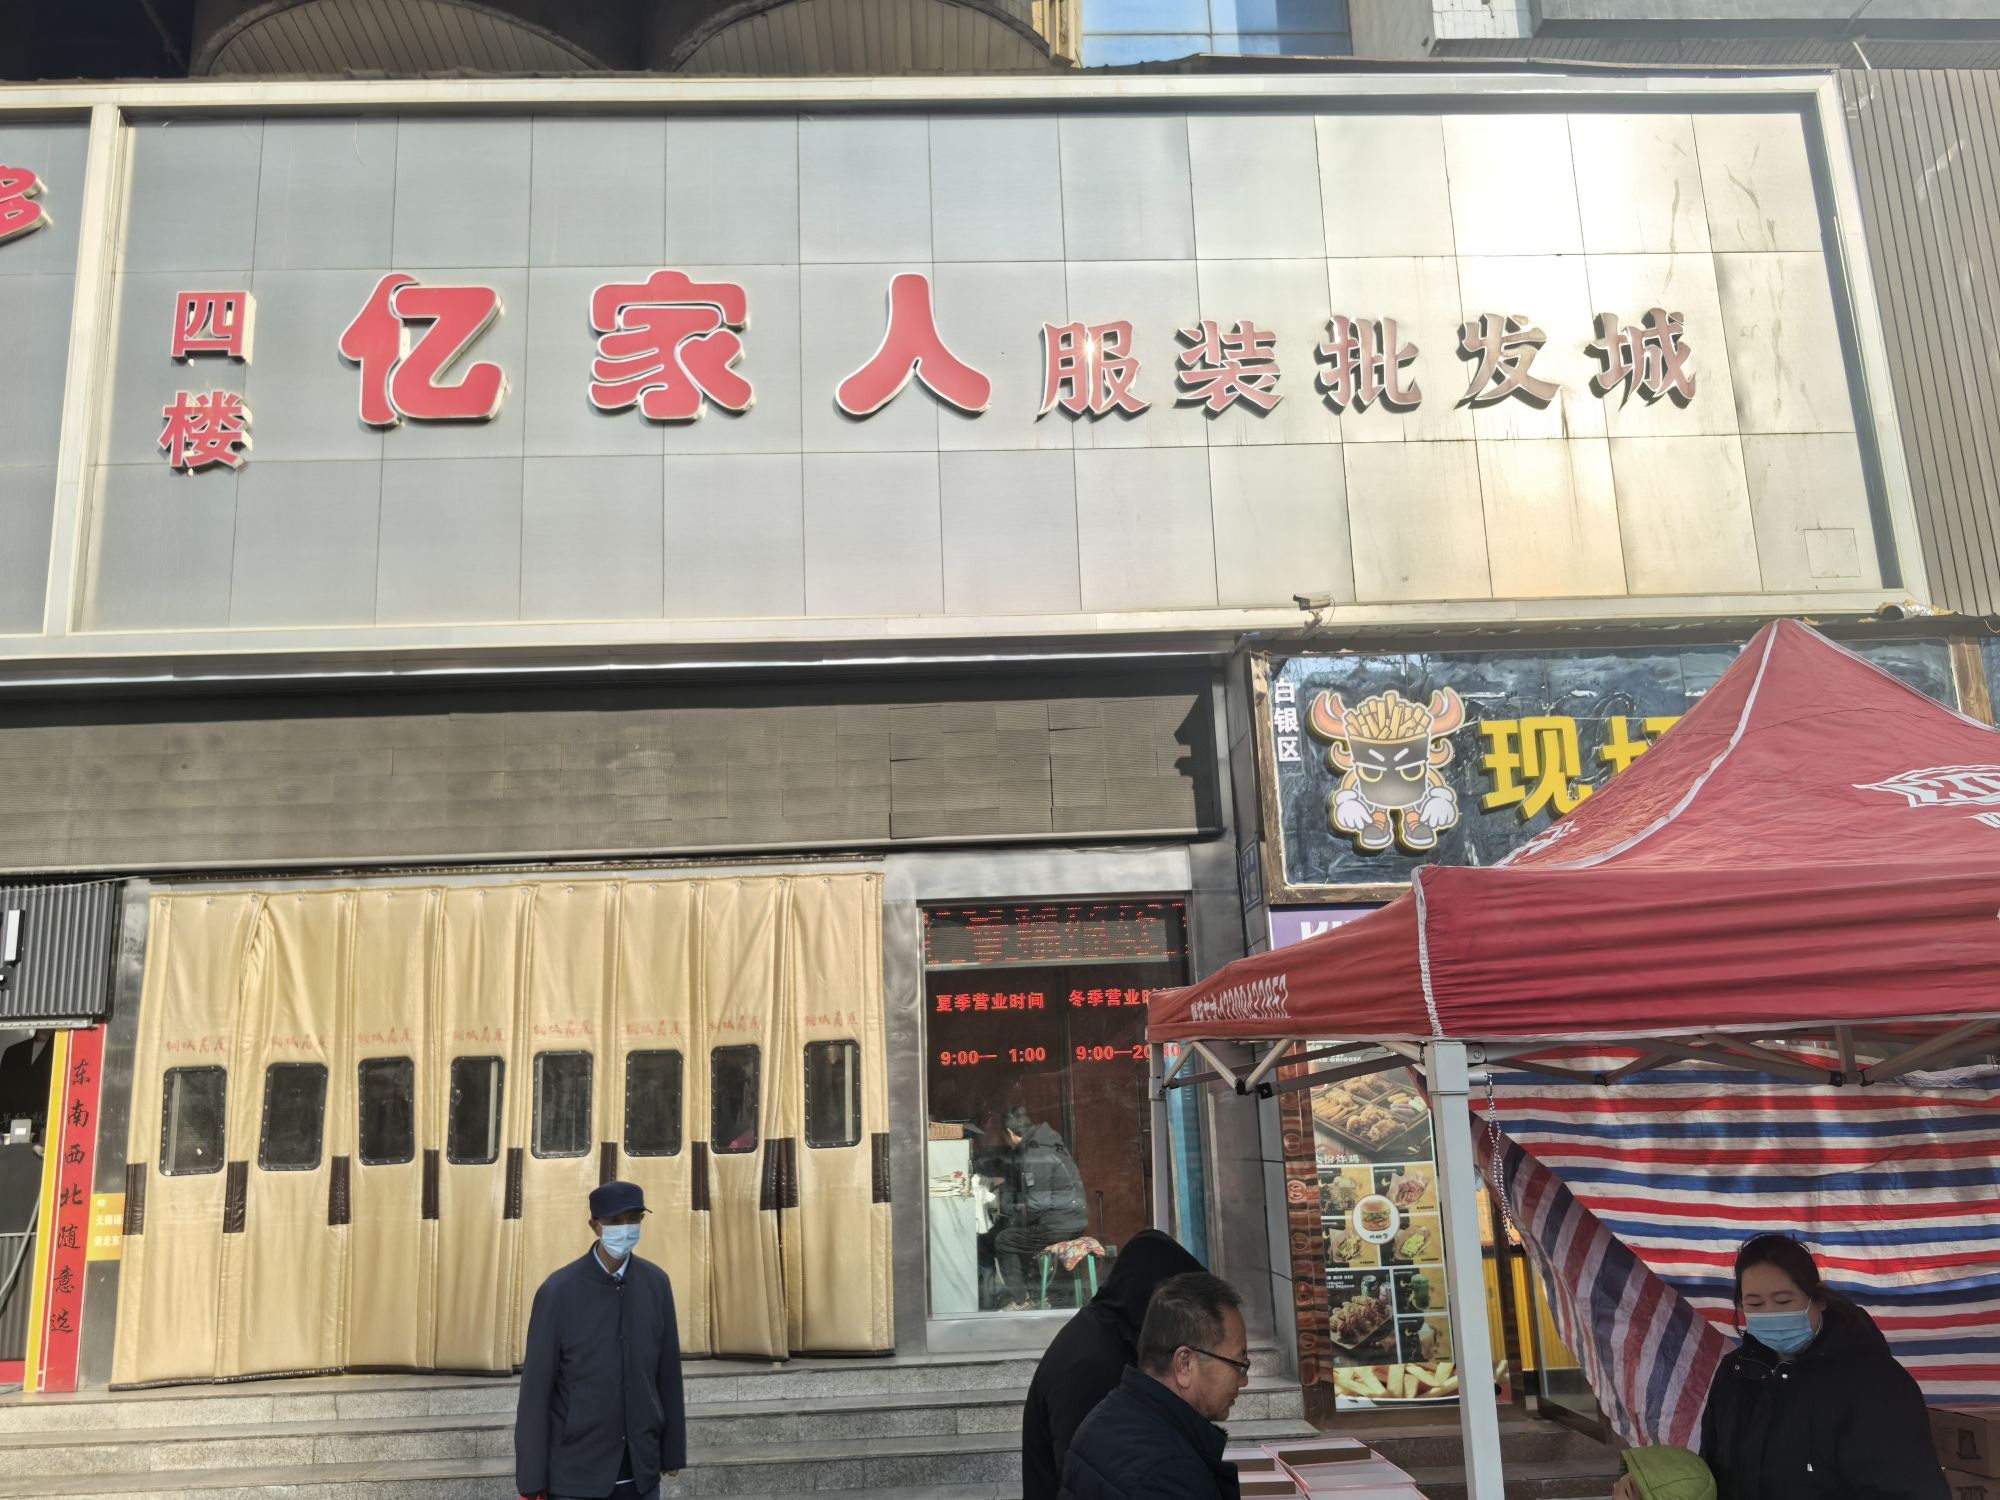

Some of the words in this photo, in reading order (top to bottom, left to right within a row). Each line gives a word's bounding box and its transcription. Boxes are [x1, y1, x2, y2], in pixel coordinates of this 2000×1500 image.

[158, 289, 256, 470] 四楼
[1274, 678, 1301, 761] 白银区
[936, 992, 1045, 1012] 夏季营业时间
[50, 1058, 92, 1333] 东南西北随意选
